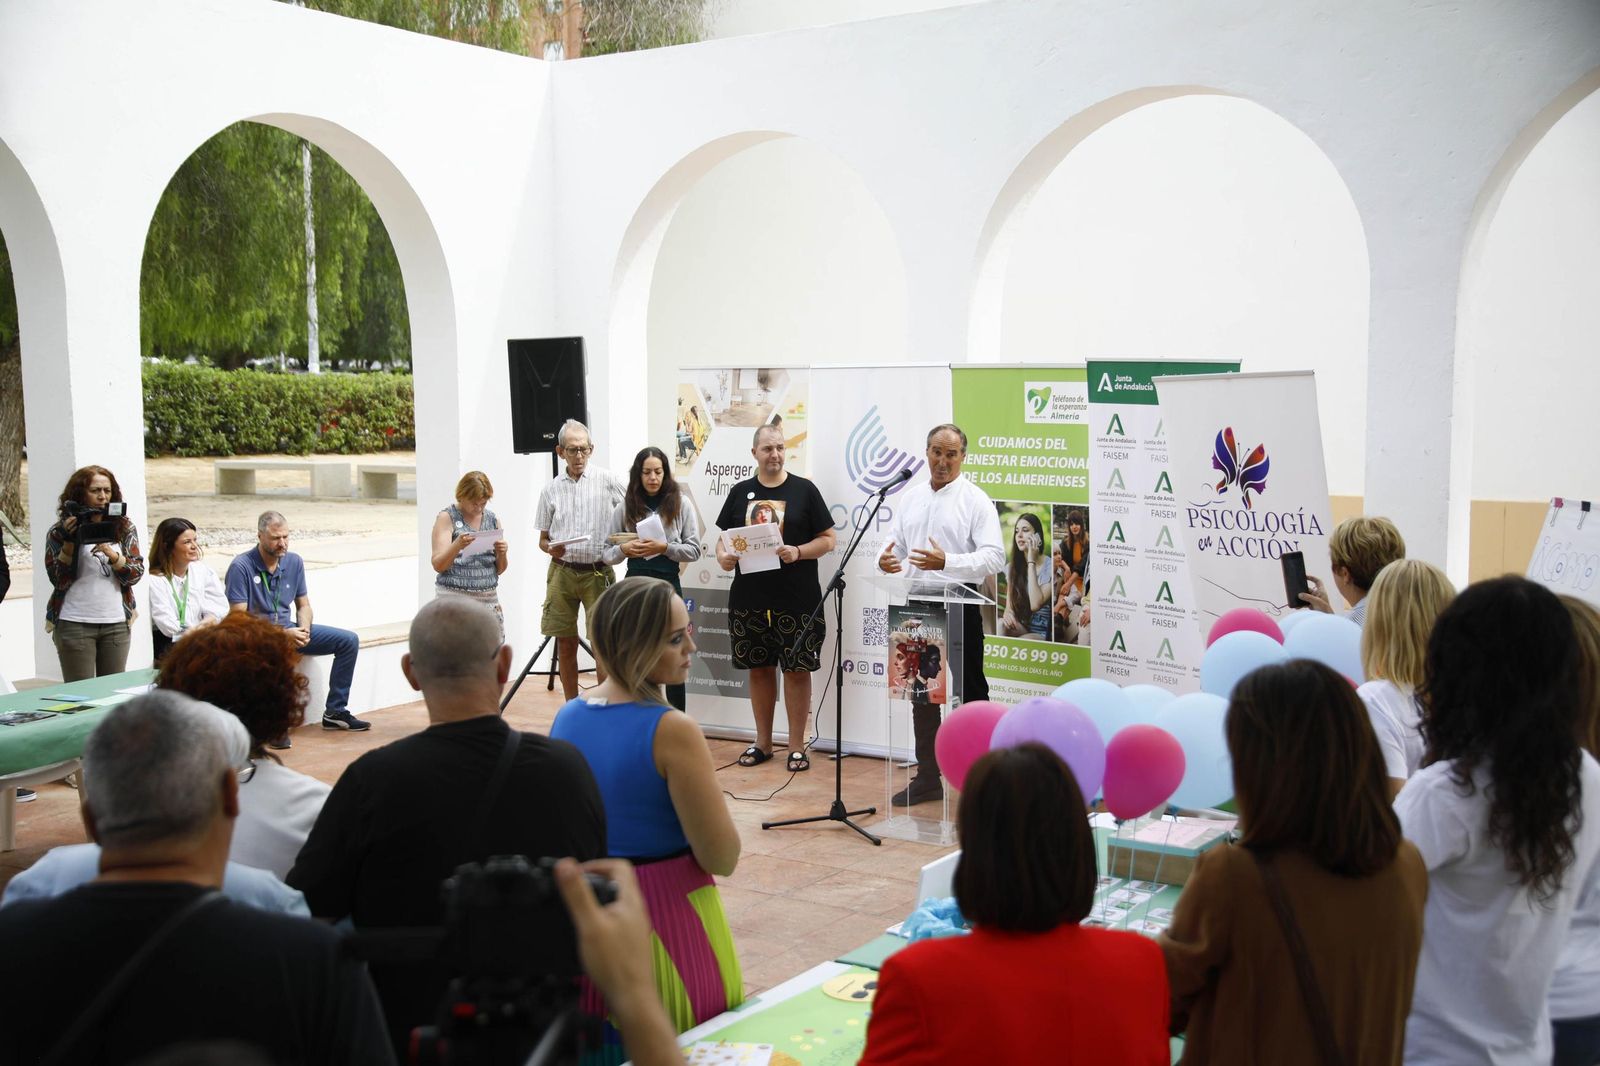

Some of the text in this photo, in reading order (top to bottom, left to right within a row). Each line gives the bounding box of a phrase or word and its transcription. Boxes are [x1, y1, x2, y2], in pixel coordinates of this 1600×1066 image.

[1123, 382, 1154, 391] Andalucía
[978, 436, 1068, 450] CUIDAMOS DEL
[962, 454, 1018, 467] IENESTAR
[1103, 452, 1128, 460] FAISEM
[1151, 455, 1168, 463] FAIS
[704, 461, 752, 480] Asperger
[963, 471, 1086, 488] DE LOS ALMERIENSES
[1104, 505, 1129, 514] FAISEM
[1151, 509, 1176, 519] FAISEM
[830, 504, 893, 532] COP
[1186, 506, 1324, 536] PSICOLOGÍA
[1198, 534, 1299, 560] en ACCIÓN
[1104, 558, 1128, 567] FAISEM
[1152, 563, 1177, 573] FAISEM
[1105, 611, 1130, 621] FAISEM
[1152, 618, 1178, 628] FAISEM
[984, 644, 1068, 665] 950 26 99 99
[1029, 666, 1041, 675] DÍAS
[1106, 666, 1130, 677] FAISEM
[1153, 674, 1178, 686] FAISEM
[1008, 686, 1032, 696] CURSOS
